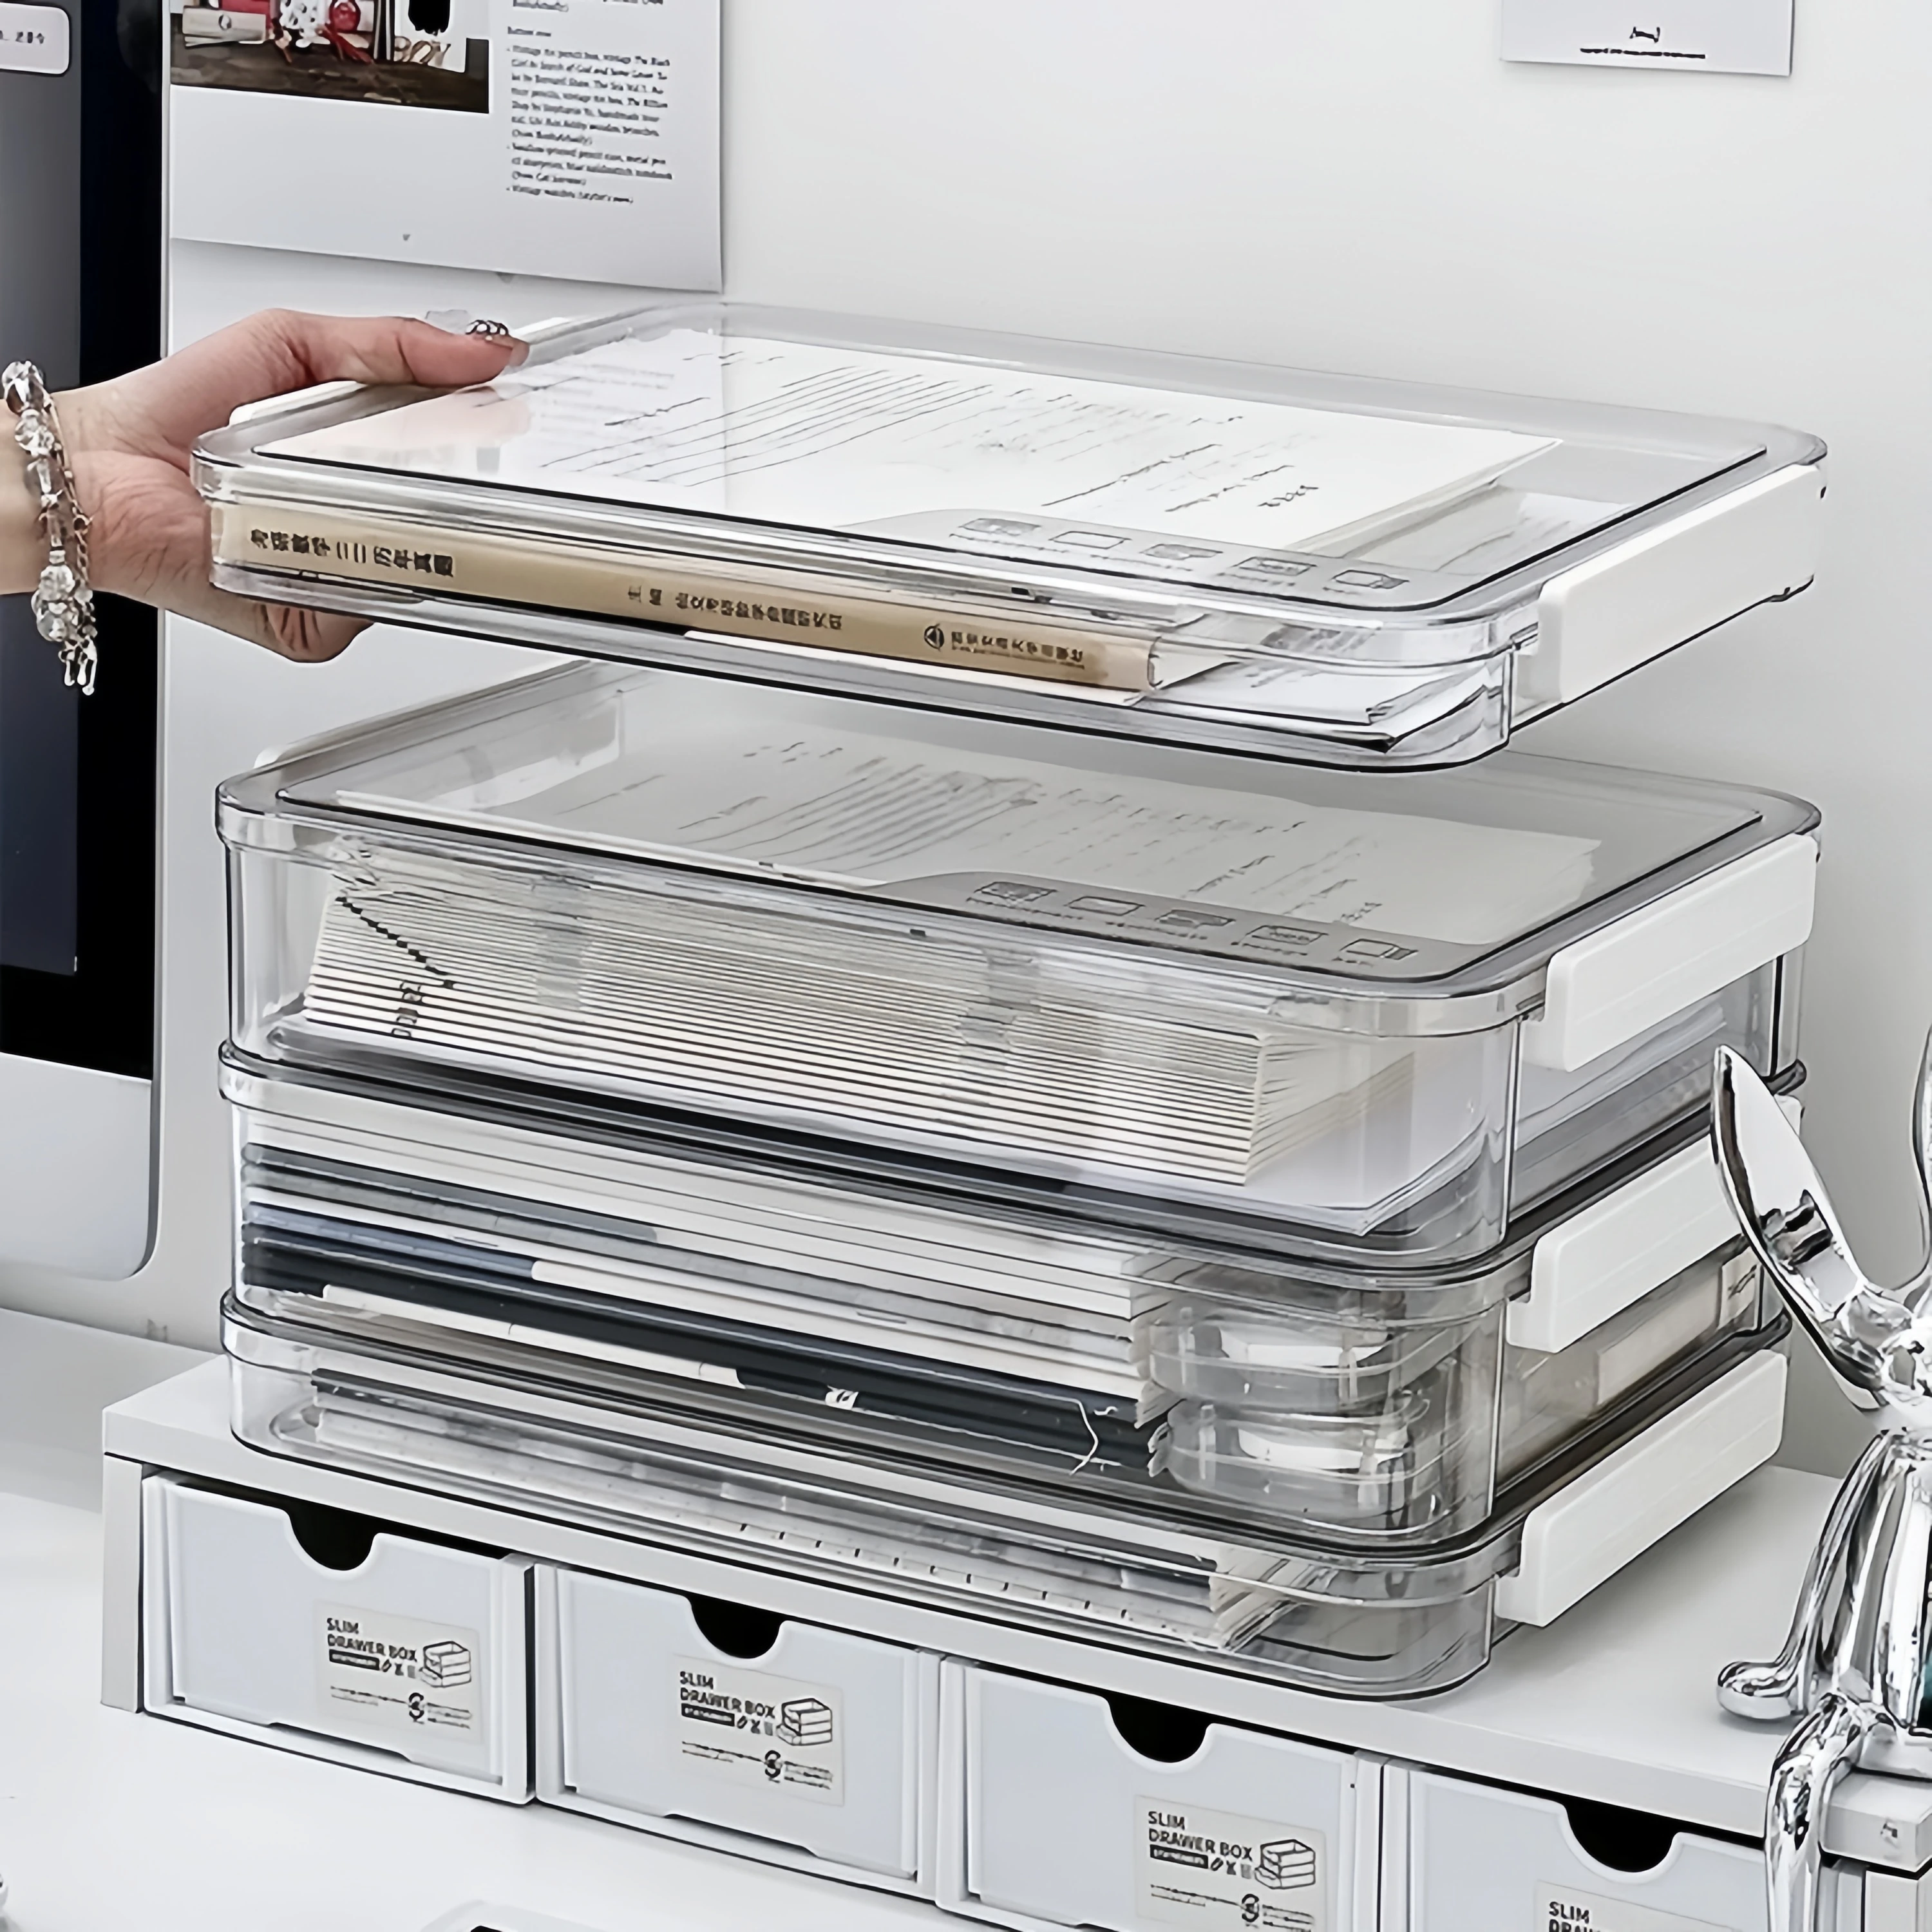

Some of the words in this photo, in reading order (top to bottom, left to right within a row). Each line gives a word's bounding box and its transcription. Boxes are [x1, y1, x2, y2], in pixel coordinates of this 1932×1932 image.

[327, 1618, 359, 1634] SLIM
[680, 1671, 714, 1689] SLIM
[745, 1700, 775, 1719] BOX
[1148, 1811, 1185, 1830] SLIM
[1149, 1828, 1215, 1853] DRAWER
[1220, 1842, 1253, 1861] BOX
[1549, 1901, 1589, 1924] SLIM
